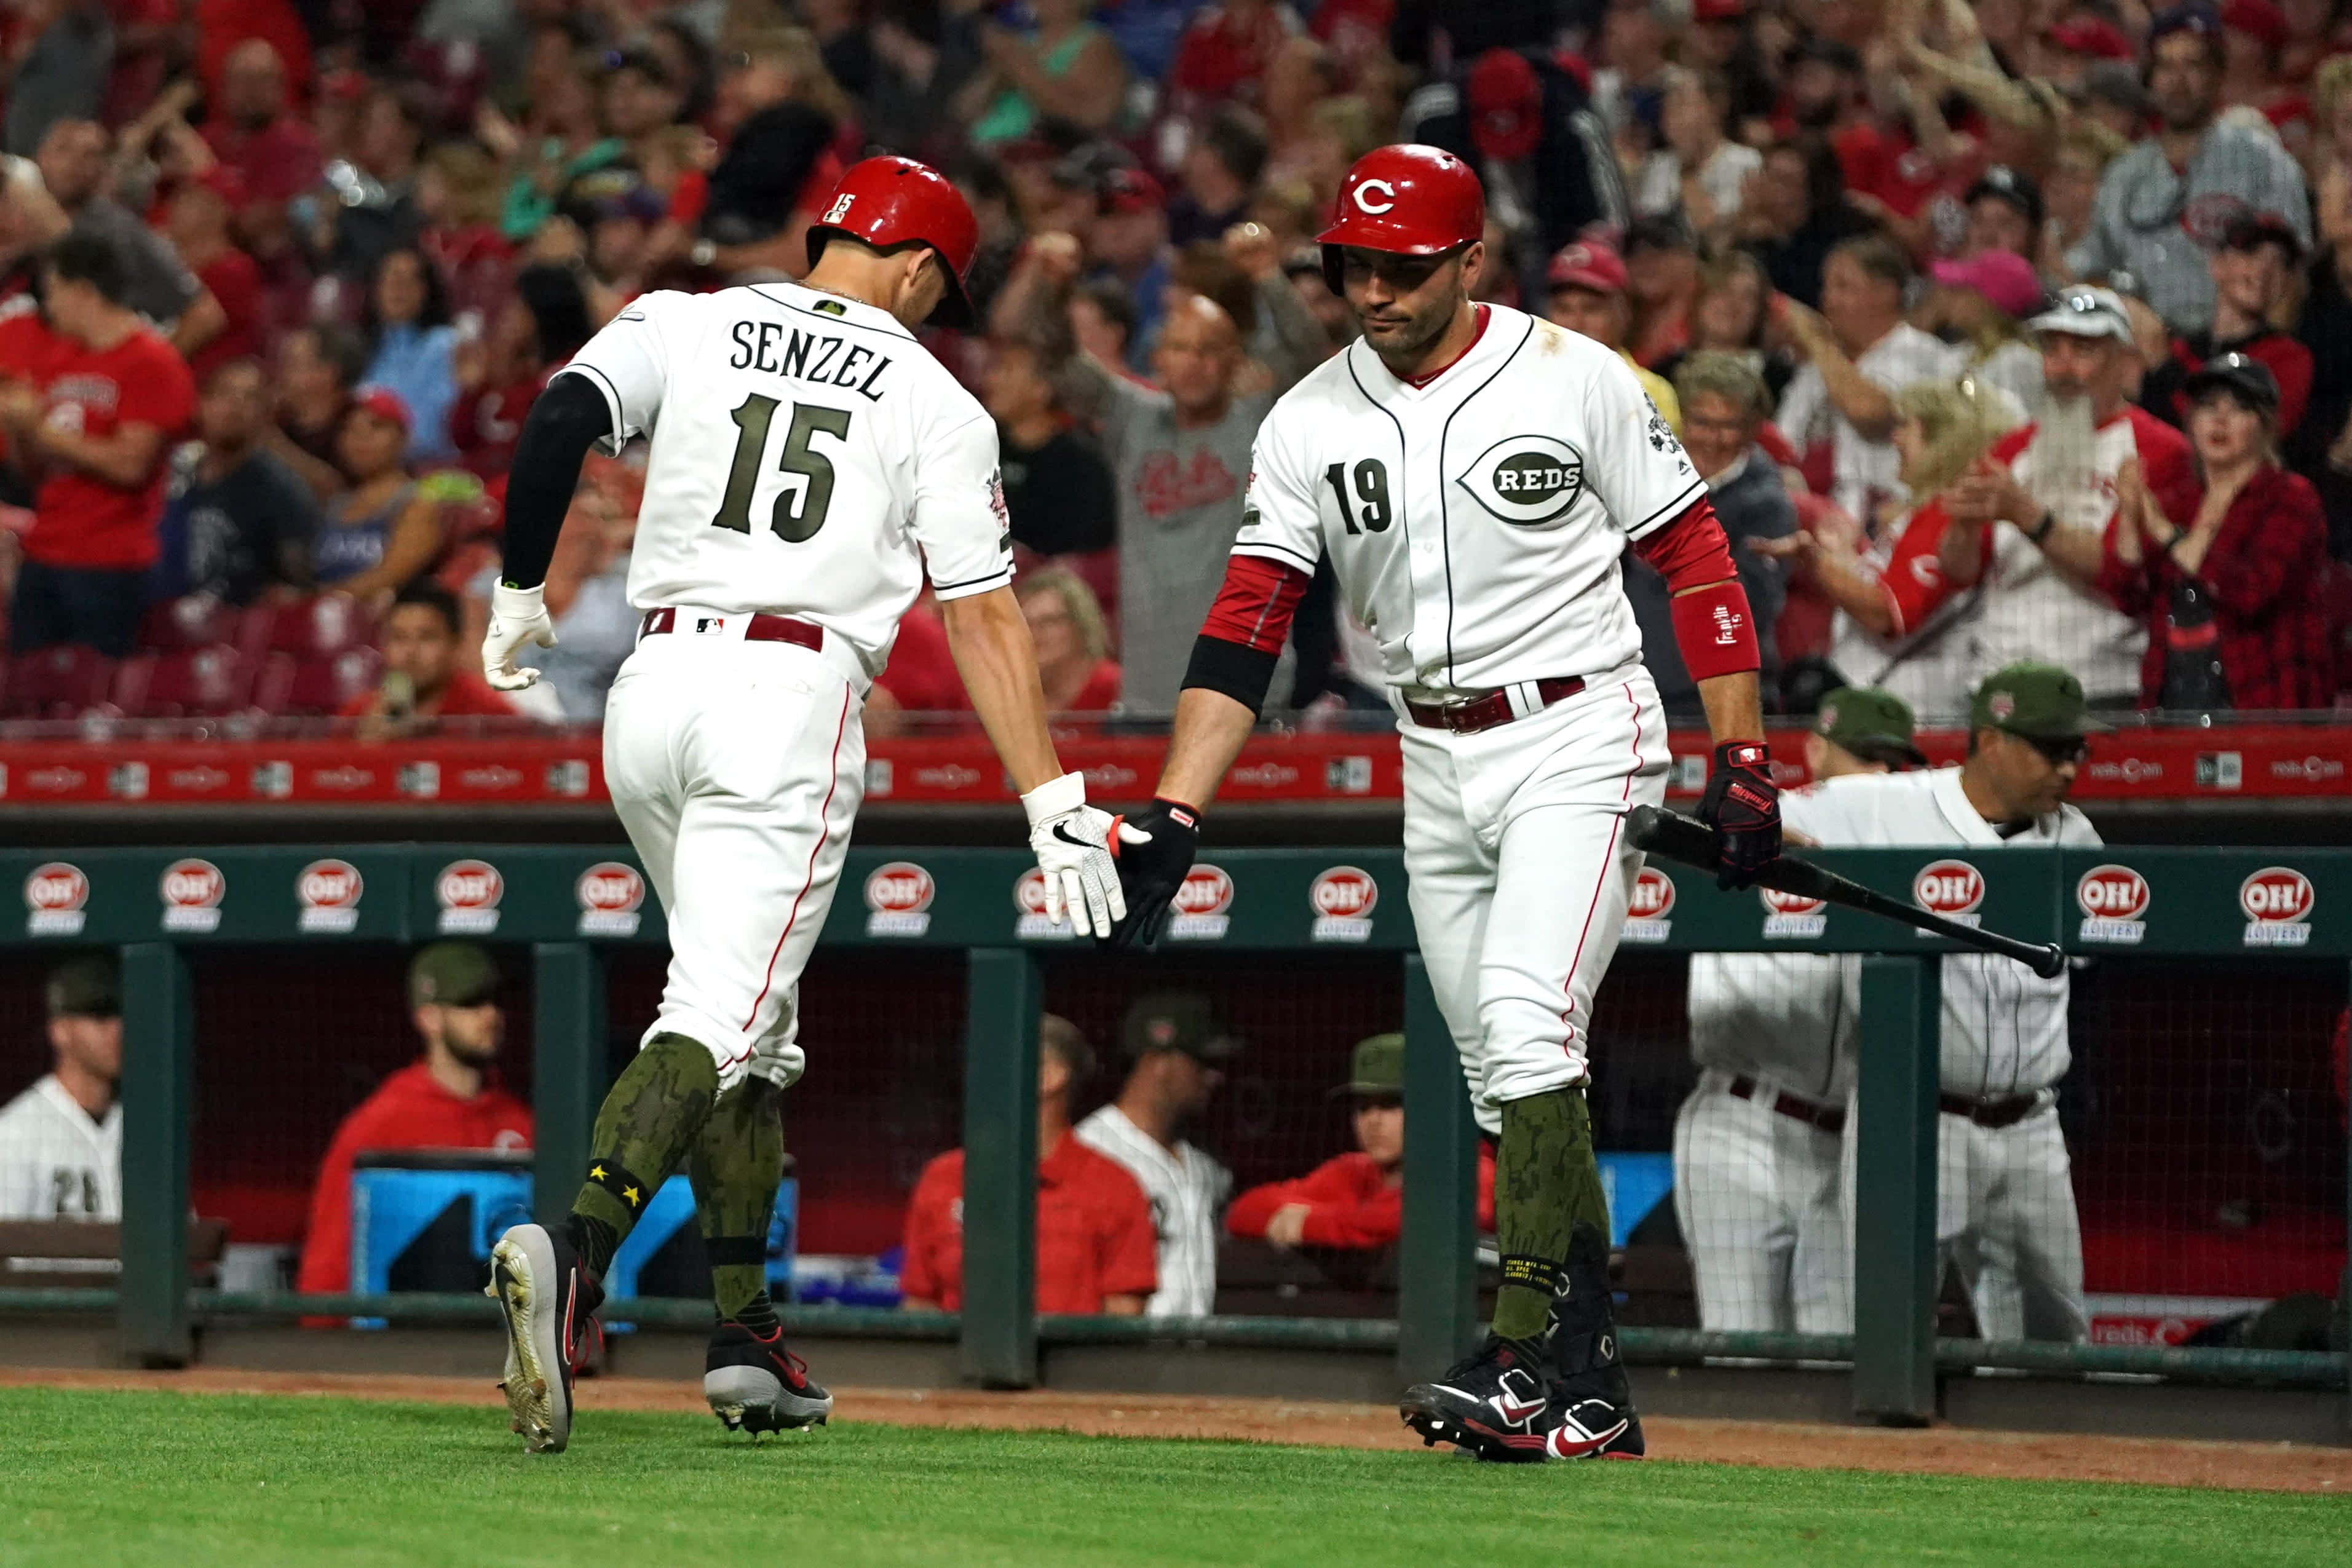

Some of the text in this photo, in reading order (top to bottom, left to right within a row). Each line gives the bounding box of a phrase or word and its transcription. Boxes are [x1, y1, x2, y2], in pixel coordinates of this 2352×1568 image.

[832, 193, 857, 213] 15
[1353, 179, 1395, 215] C
[731, 321, 893, 402] SENZEL
[711, 392, 852, 543] 15
[1497, 467, 1582, 491] REDS
[1326, 458, 1392, 535] 19
[1731, 614, 1743, 628] 19
[873, 876, 927, 905] OH!
[1317, 879, 1372, 907] OH!
[1634, 879, 1669, 910] H!
[1919, 871, 1976, 904] OH!
[2083, 877, 2142, 909] OH!
[2246, 879, 2306, 913] OH!
